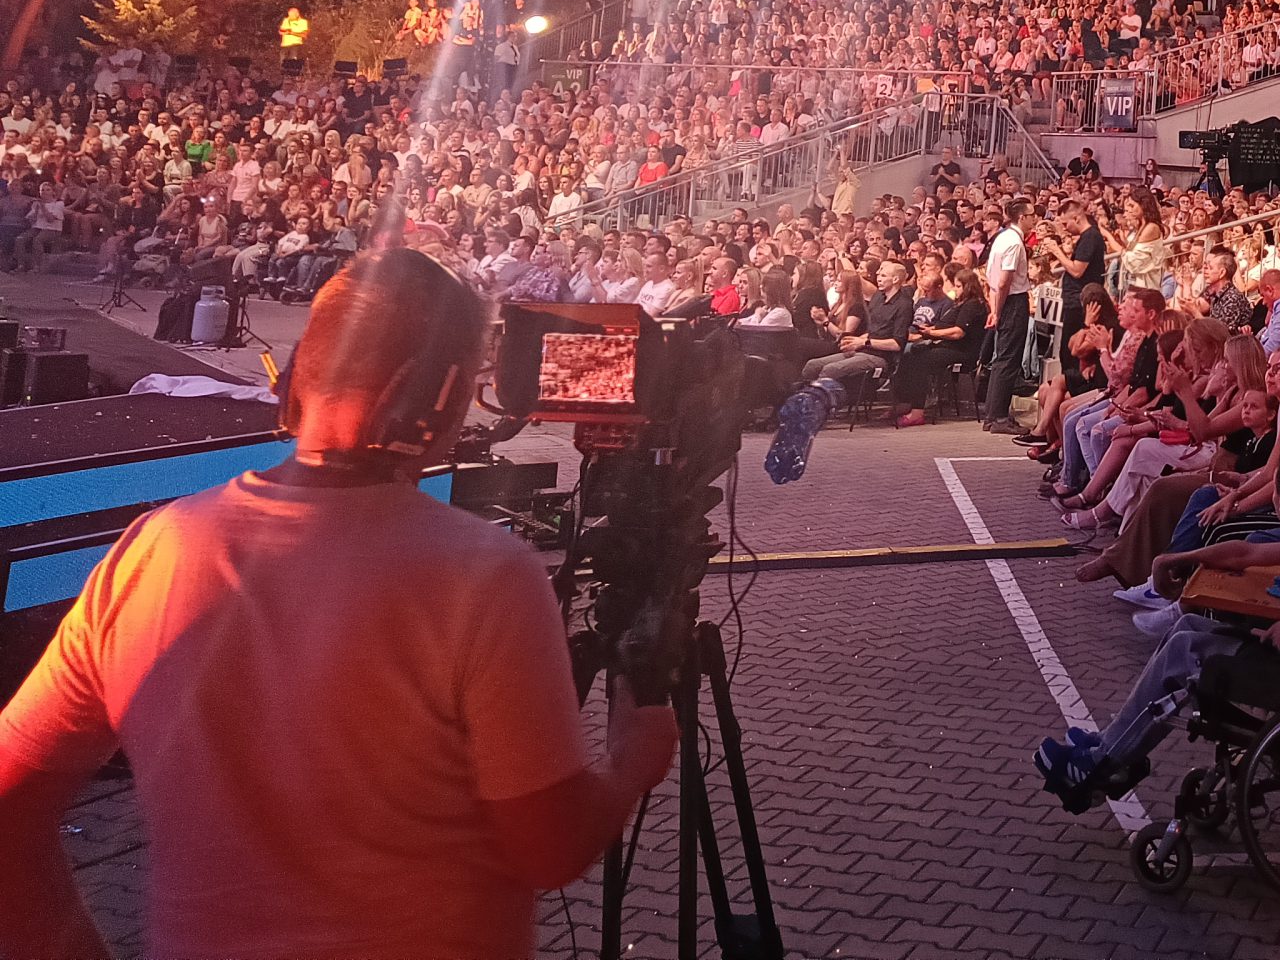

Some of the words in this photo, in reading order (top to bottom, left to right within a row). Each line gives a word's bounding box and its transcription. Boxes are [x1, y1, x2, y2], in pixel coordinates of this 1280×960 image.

[566, 69, 583, 79] VIP
[1106, 96, 1132, 116] VIP
[1040, 298, 1064, 323] VI
